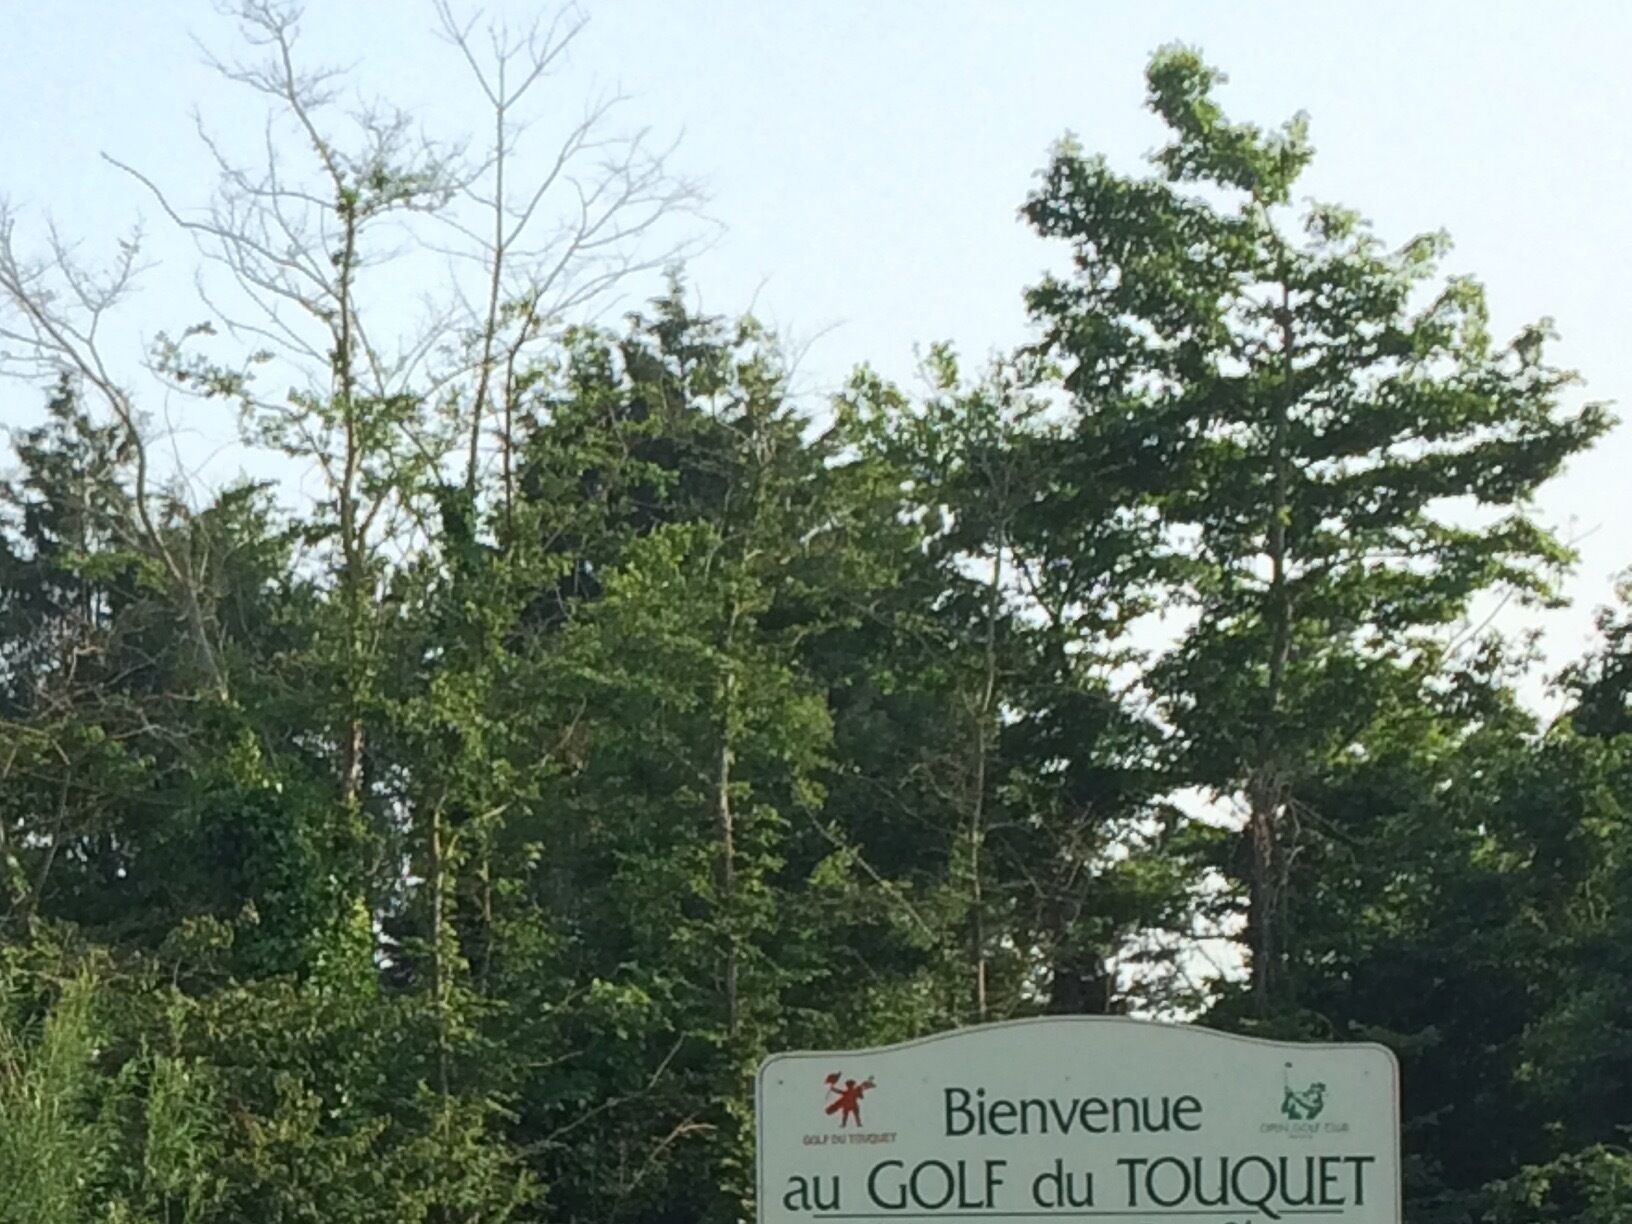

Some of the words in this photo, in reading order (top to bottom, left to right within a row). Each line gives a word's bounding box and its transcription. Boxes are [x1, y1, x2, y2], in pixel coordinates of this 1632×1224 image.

[944, 1087, 1204, 1137] Bienvenue
[782, 1173, 841, 1212] au
[866, 1159, 1008, 1211] GOLF
[1032, 1158, 1095, 1209] du
[1117, 1155, 1376, 1220] TOUQUET
